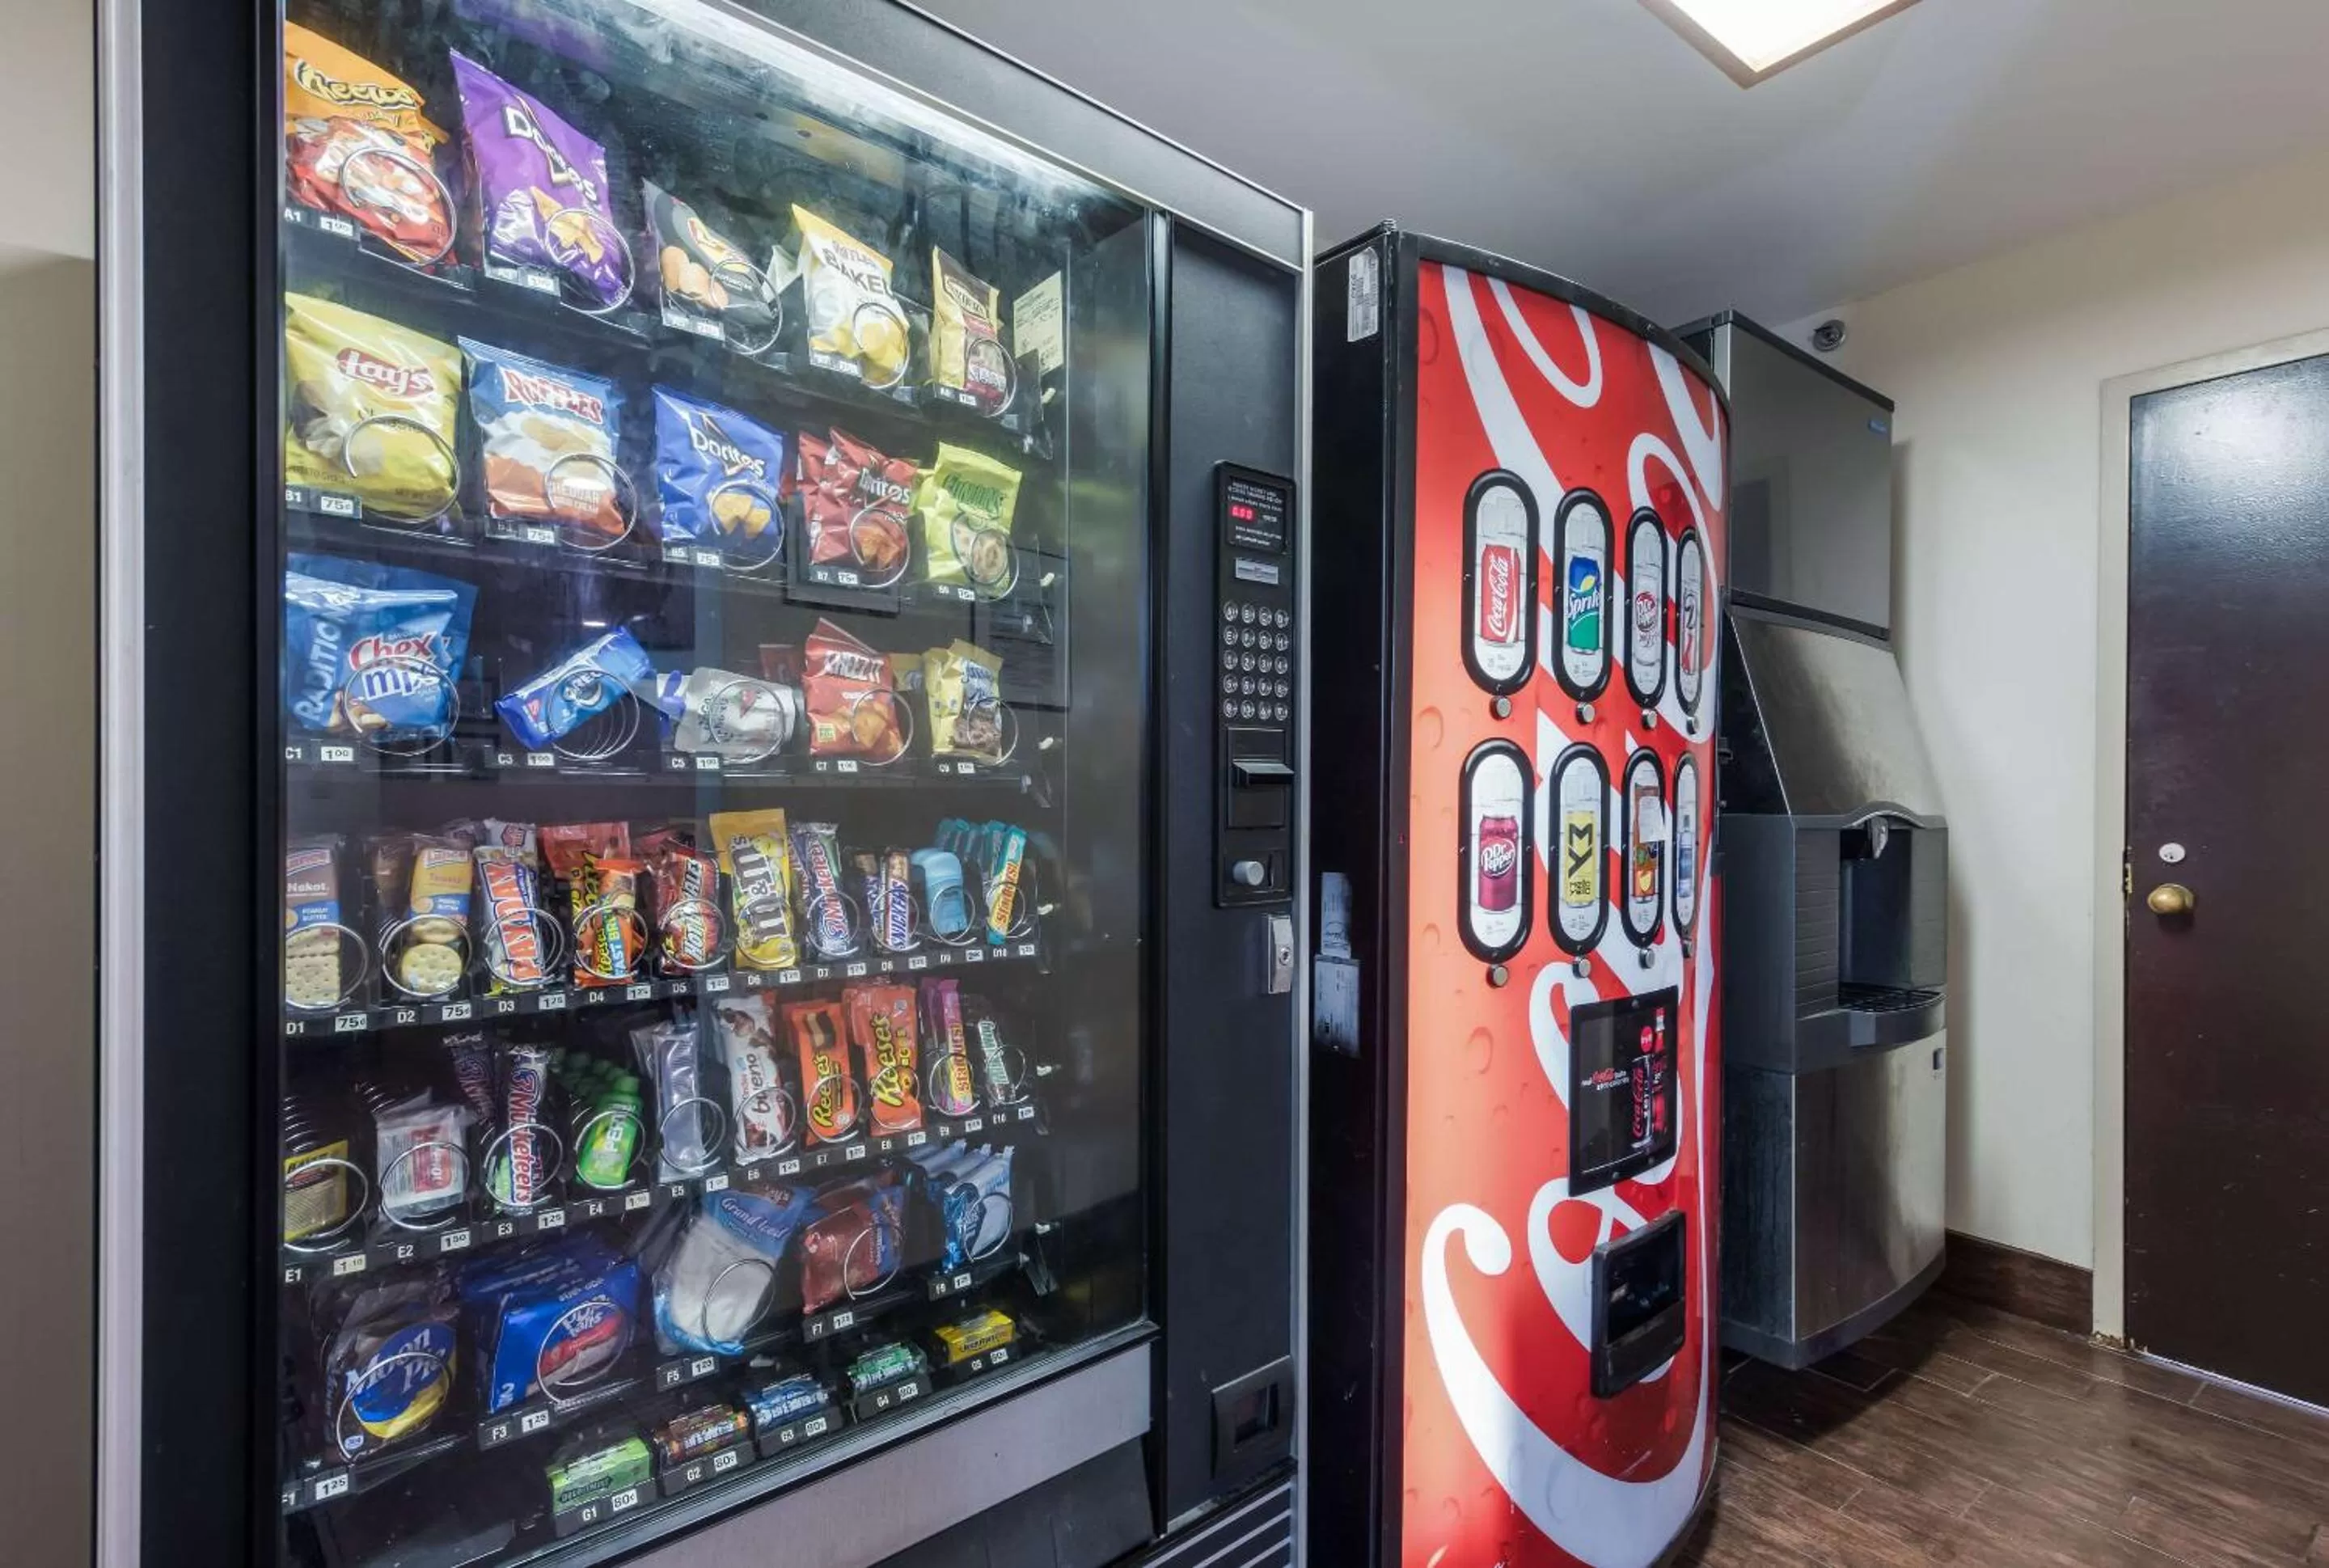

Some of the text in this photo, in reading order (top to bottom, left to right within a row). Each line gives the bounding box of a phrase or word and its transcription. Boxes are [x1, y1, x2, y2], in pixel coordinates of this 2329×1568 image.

[501, 105, 600, 204] Doritos
[284, 206, 302, 222] A1
[343, 349, 435, 397] Lay's
[502, 368, 604, 424] RUFFLES
[690, 425, 765, 479] Doritos
[1487, 553, 1509, 637] Coca-Cola
[349, 630, 438, 670] Chex
[285, 747, 302, 759] C1
[497, 754, 514, 766] C3
[1481, 848, 1515, 872] Pepper
[481, 862, 544, 982] PAYDAY
[889, 879, 910, 951] SNICKERS
[672, 982, 687, 993] D5
[590, 991, 604, 1003] D4
[446, 1005, 471, 1018] 75¢
[499, 1000, 515, 1012] D3
[338, 1016, 366, 1029] 75¢
[398, 1011, 416, 1024] D2
[286, 1021, 304, 1034] D1
[869, 1012, 904, 1108] Reese's
[810, 1052, 835, 1129] Reese's
[671, 1185, 685, 1198] E5
[590, 1202, 603, 1215] E4
[498, 1223, 513, 1235] E3
[397, 1245, 414, 1258] E2
[285, 1268, 302, 1283] E1
[666, 1371, 680, 1384] F5
[492, 1426, 508, 1441] F3
[687, 1466, 702, 1481] G2
[582, 1507, 598, 1521] G1
